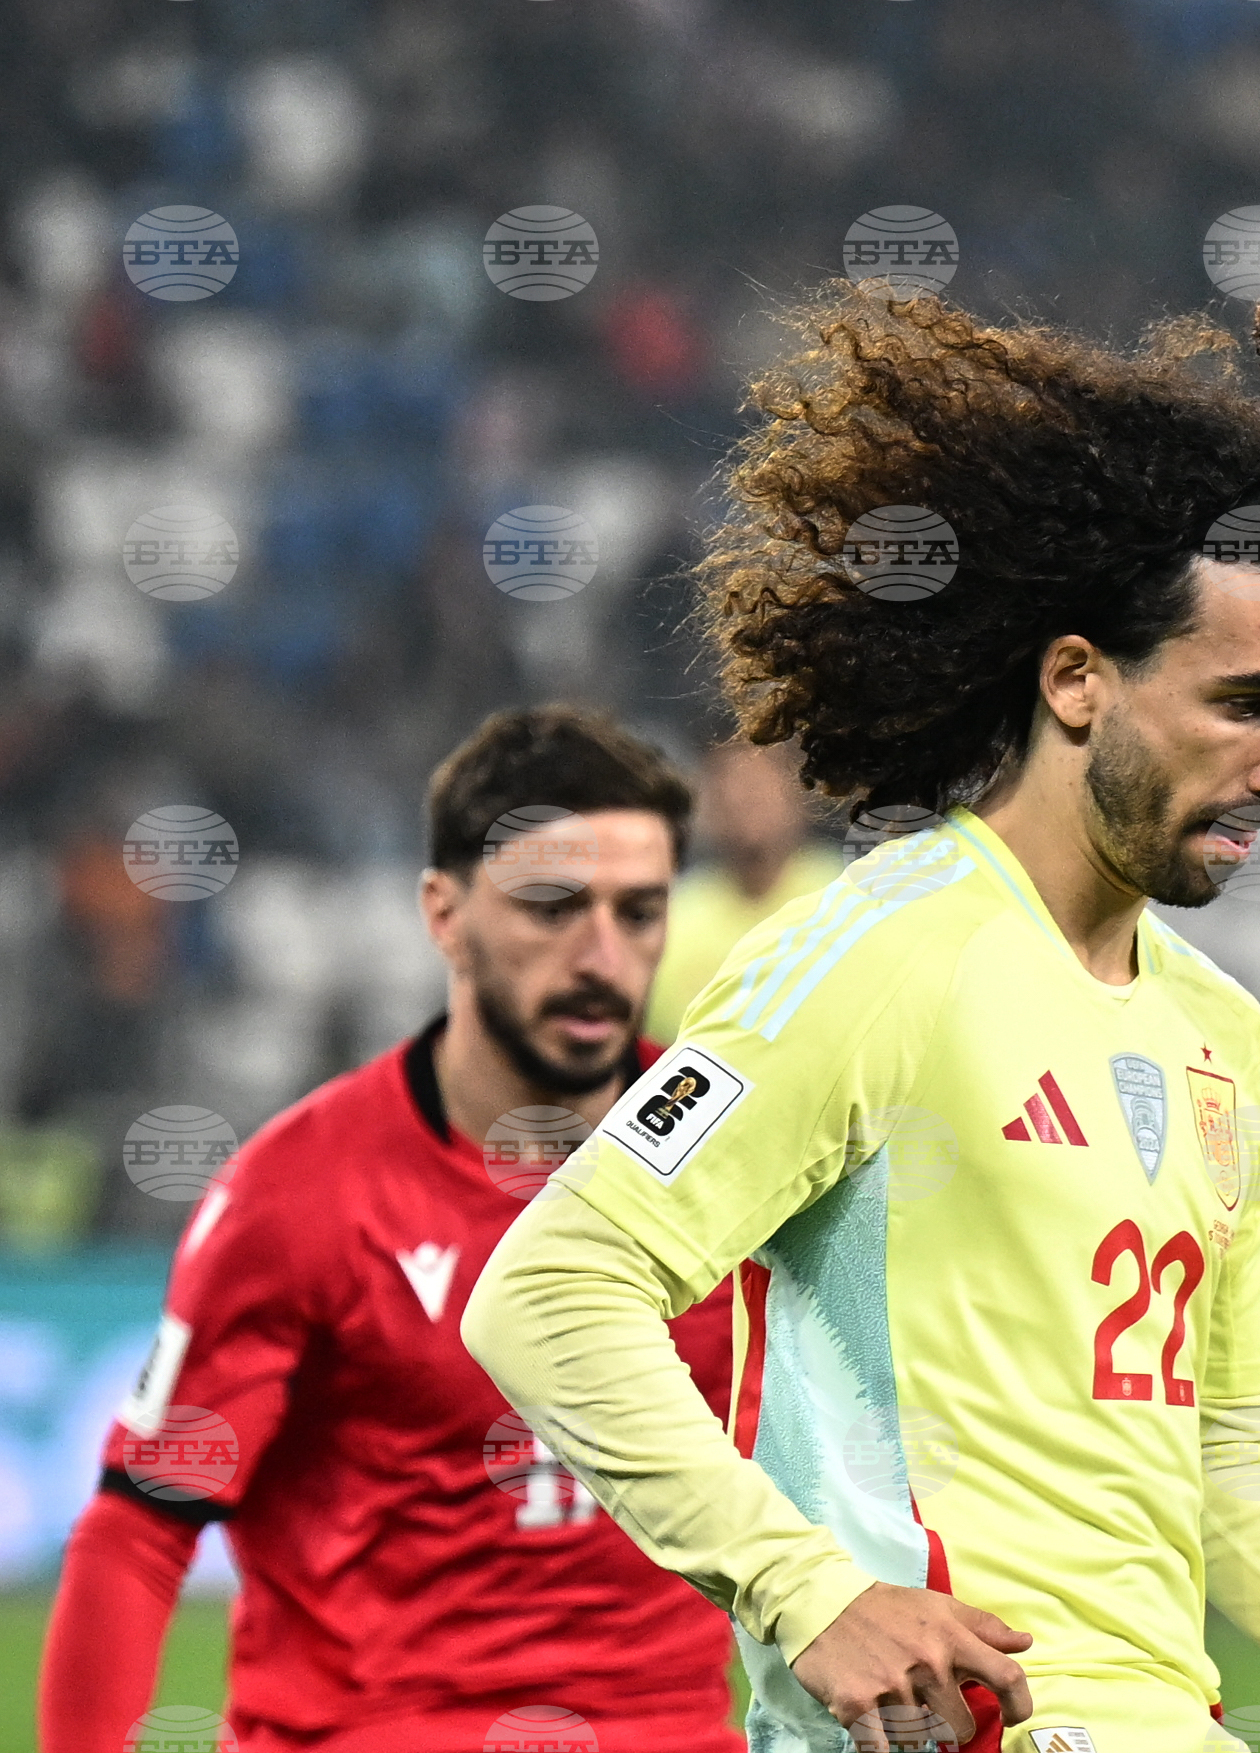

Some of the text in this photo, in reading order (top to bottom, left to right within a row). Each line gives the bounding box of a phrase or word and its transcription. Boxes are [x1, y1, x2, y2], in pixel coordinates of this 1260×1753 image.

[1116, 1069, 1161, 1087] EUROPEAN
[625, 1119, 661, 1148] QUALIFIERS
[645, 1112, 665, 1131] FIFA
[1091, 1219, 1205, 1407] 22
